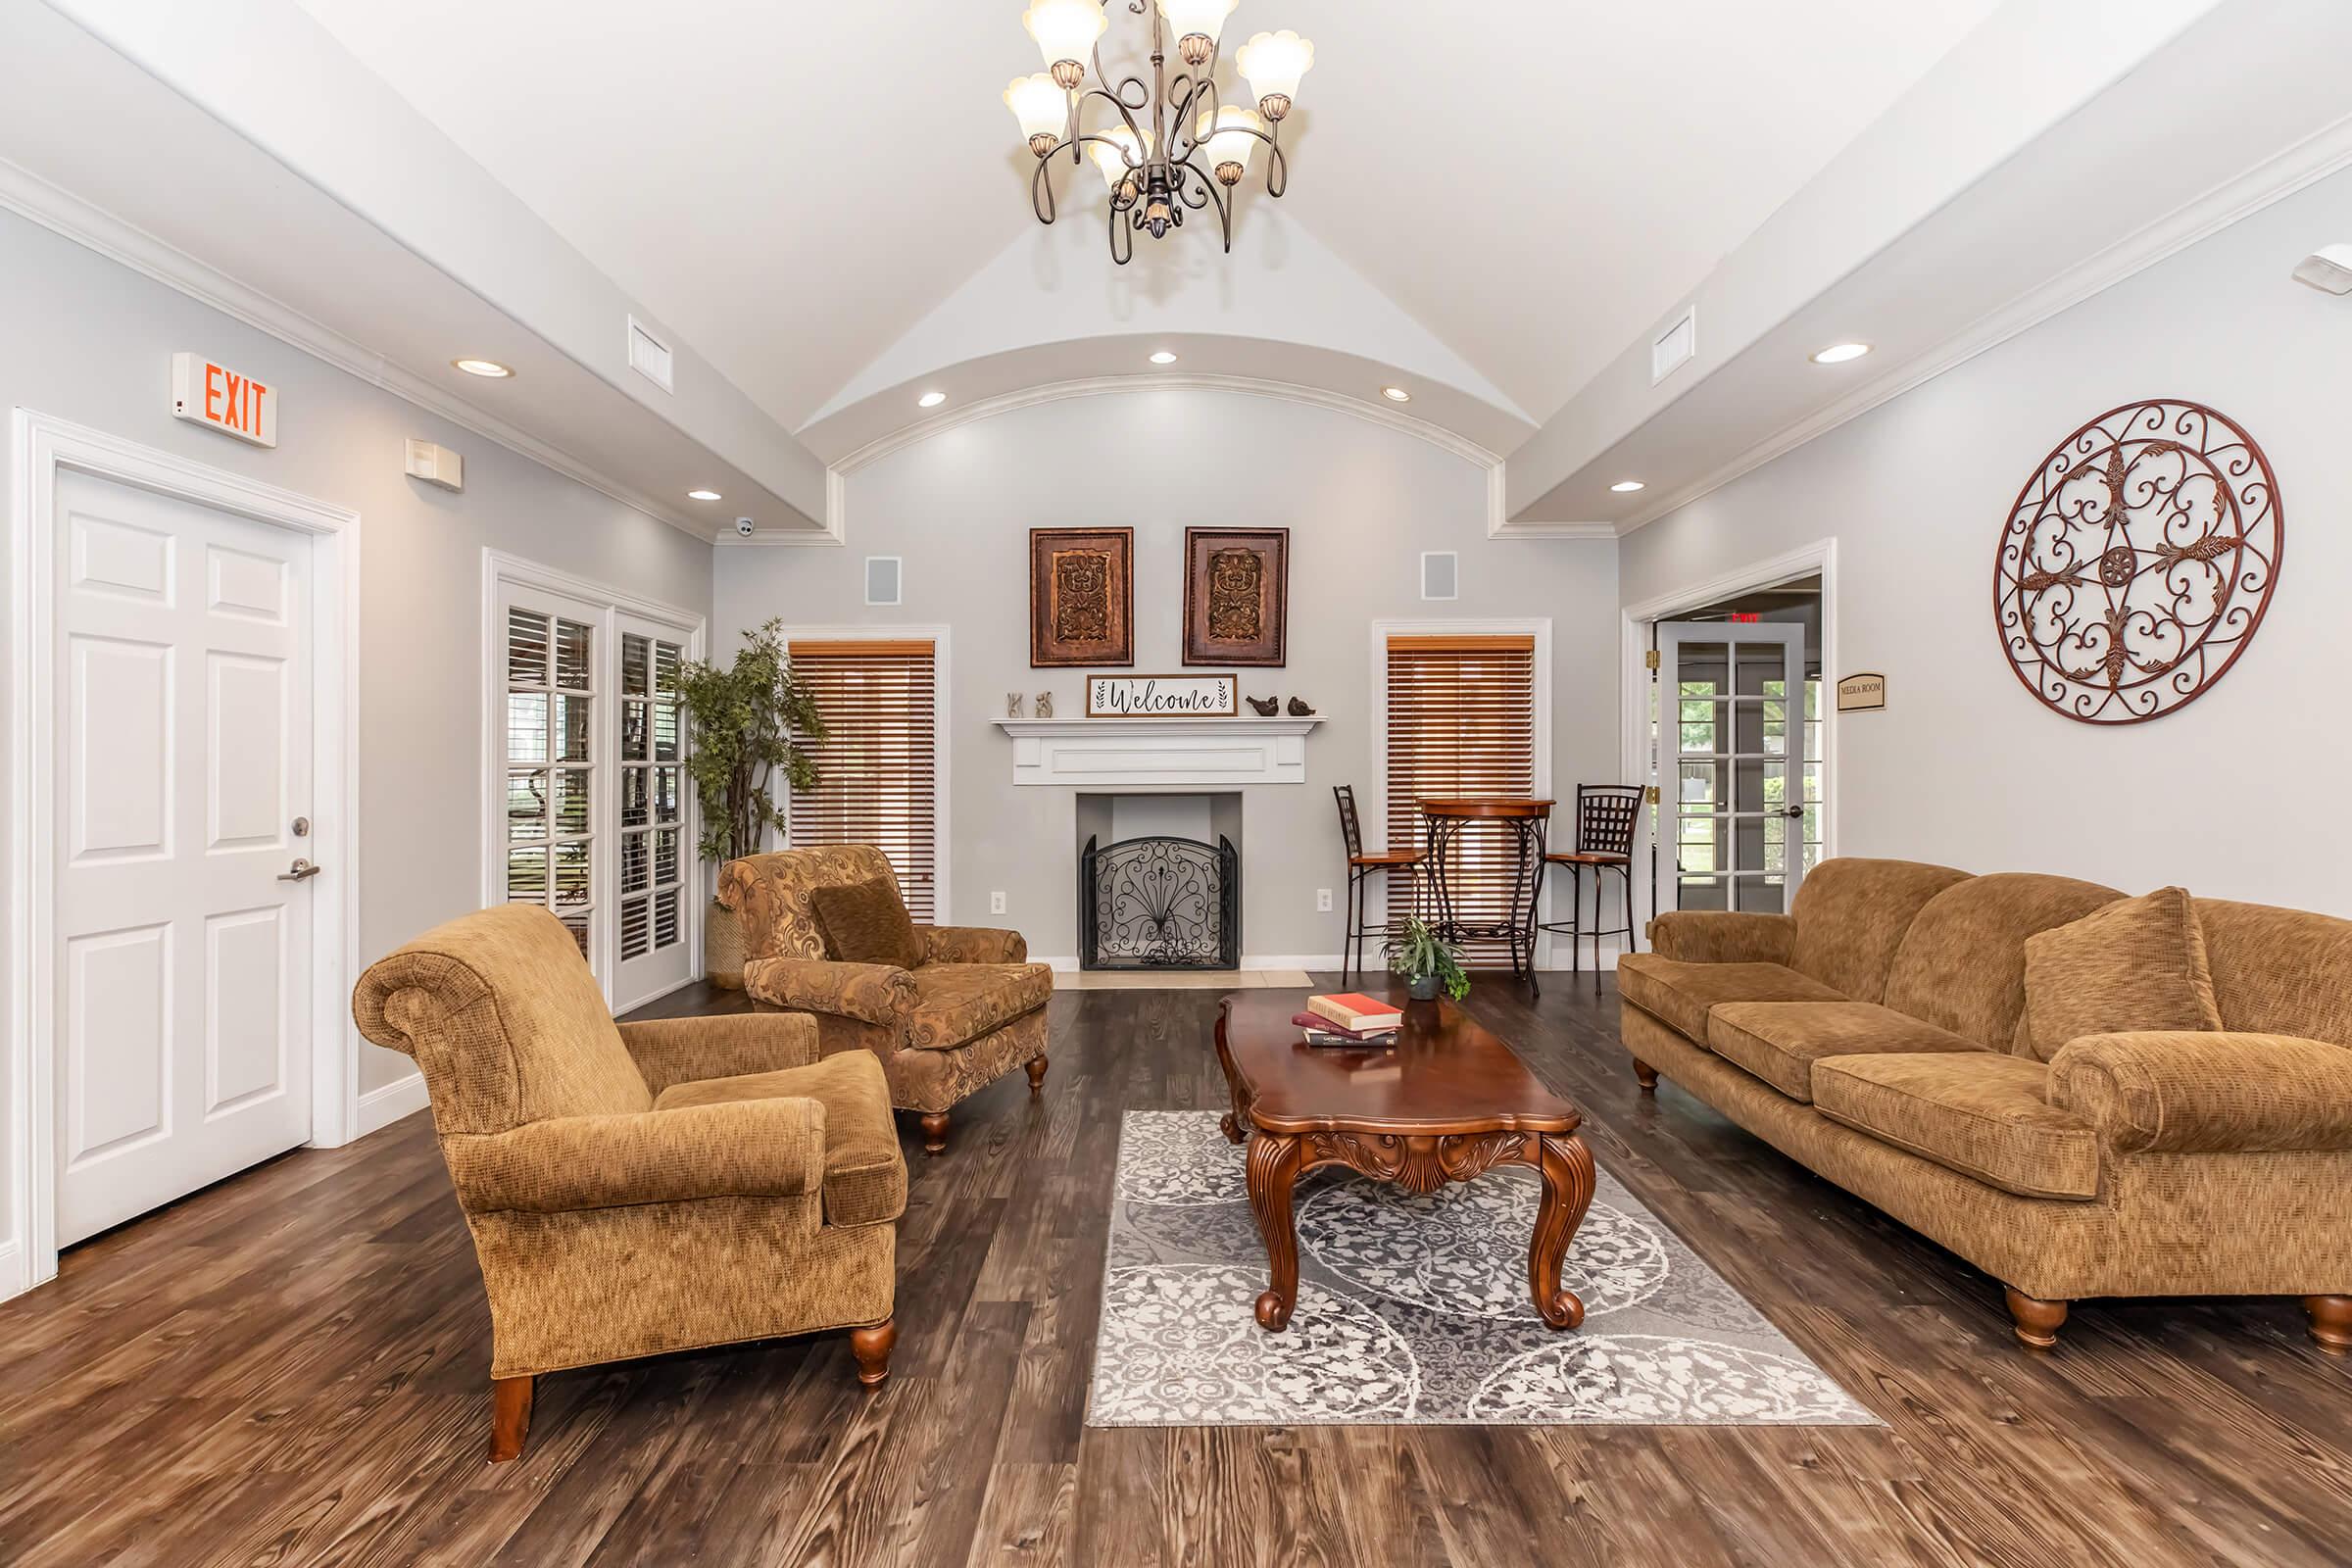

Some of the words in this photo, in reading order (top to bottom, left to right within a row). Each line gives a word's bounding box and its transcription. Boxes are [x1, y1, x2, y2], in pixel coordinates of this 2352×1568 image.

[205, 363, 267, 436] EXIT
[1110, 680, 1215, 713] Welcome
[1840, 685, 1860, 695] MEDIA
[1862, 682, 1881, 693] ROOM
